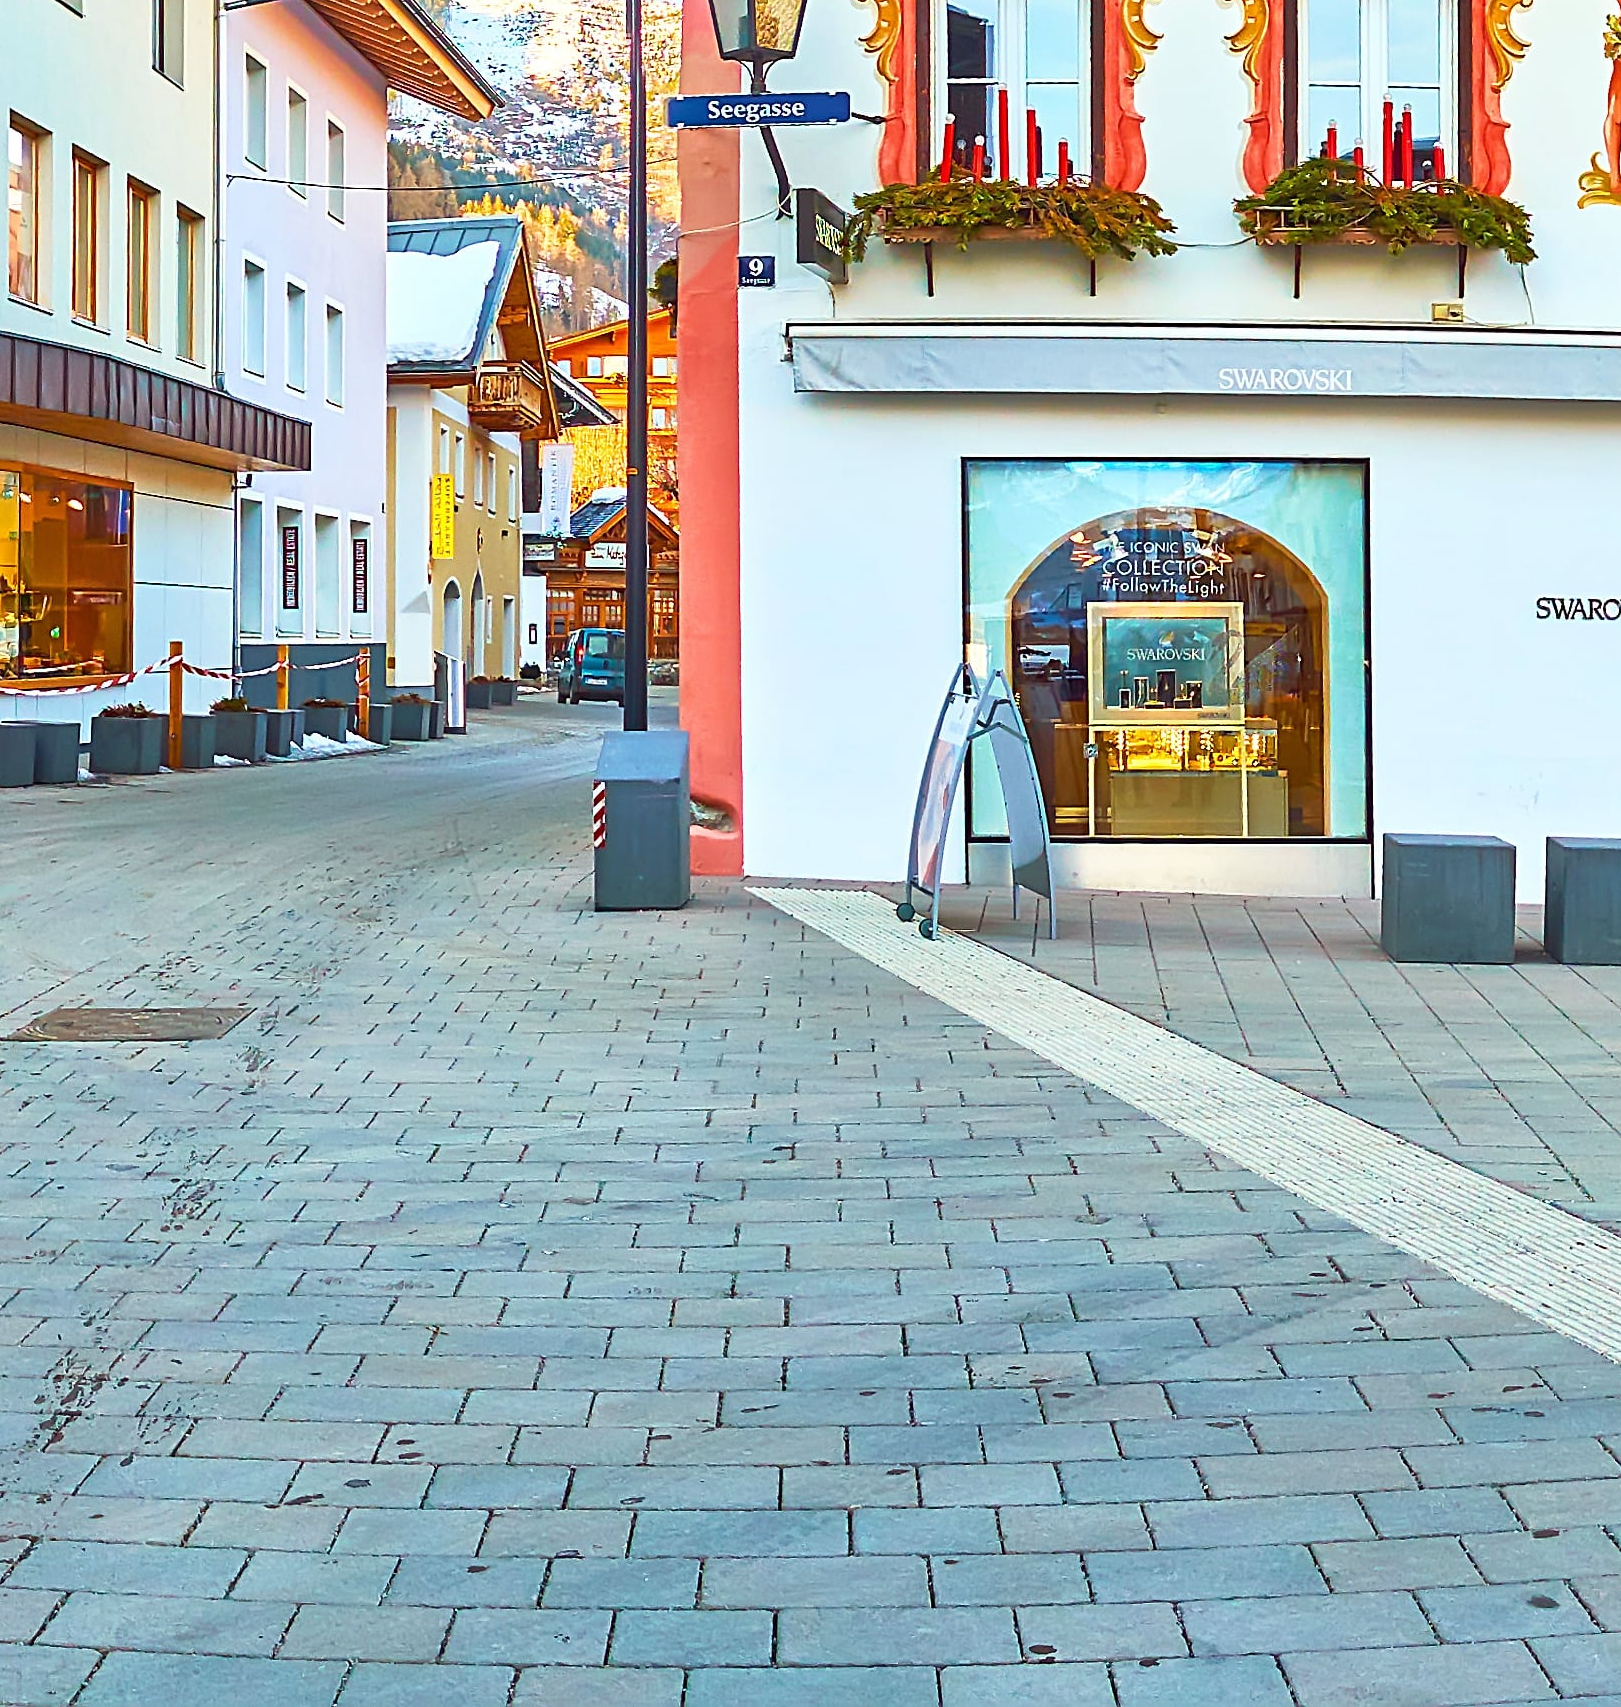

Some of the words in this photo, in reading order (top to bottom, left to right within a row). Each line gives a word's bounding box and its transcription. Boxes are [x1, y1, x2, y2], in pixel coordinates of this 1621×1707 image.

[708, 100, 805, 122] Seegasse
[749, 258, 764, 277] 9
[1219, 368, 1354, 391] SWAROVSKI
[1130, 542, 1178, 554] ICONIC
[1102, 559, 1225, 577] COLLECTION
[1102, 576, 1226, 598] #FollowTheLight
[1126, 648, 1206, 662] SWAROVSKI
